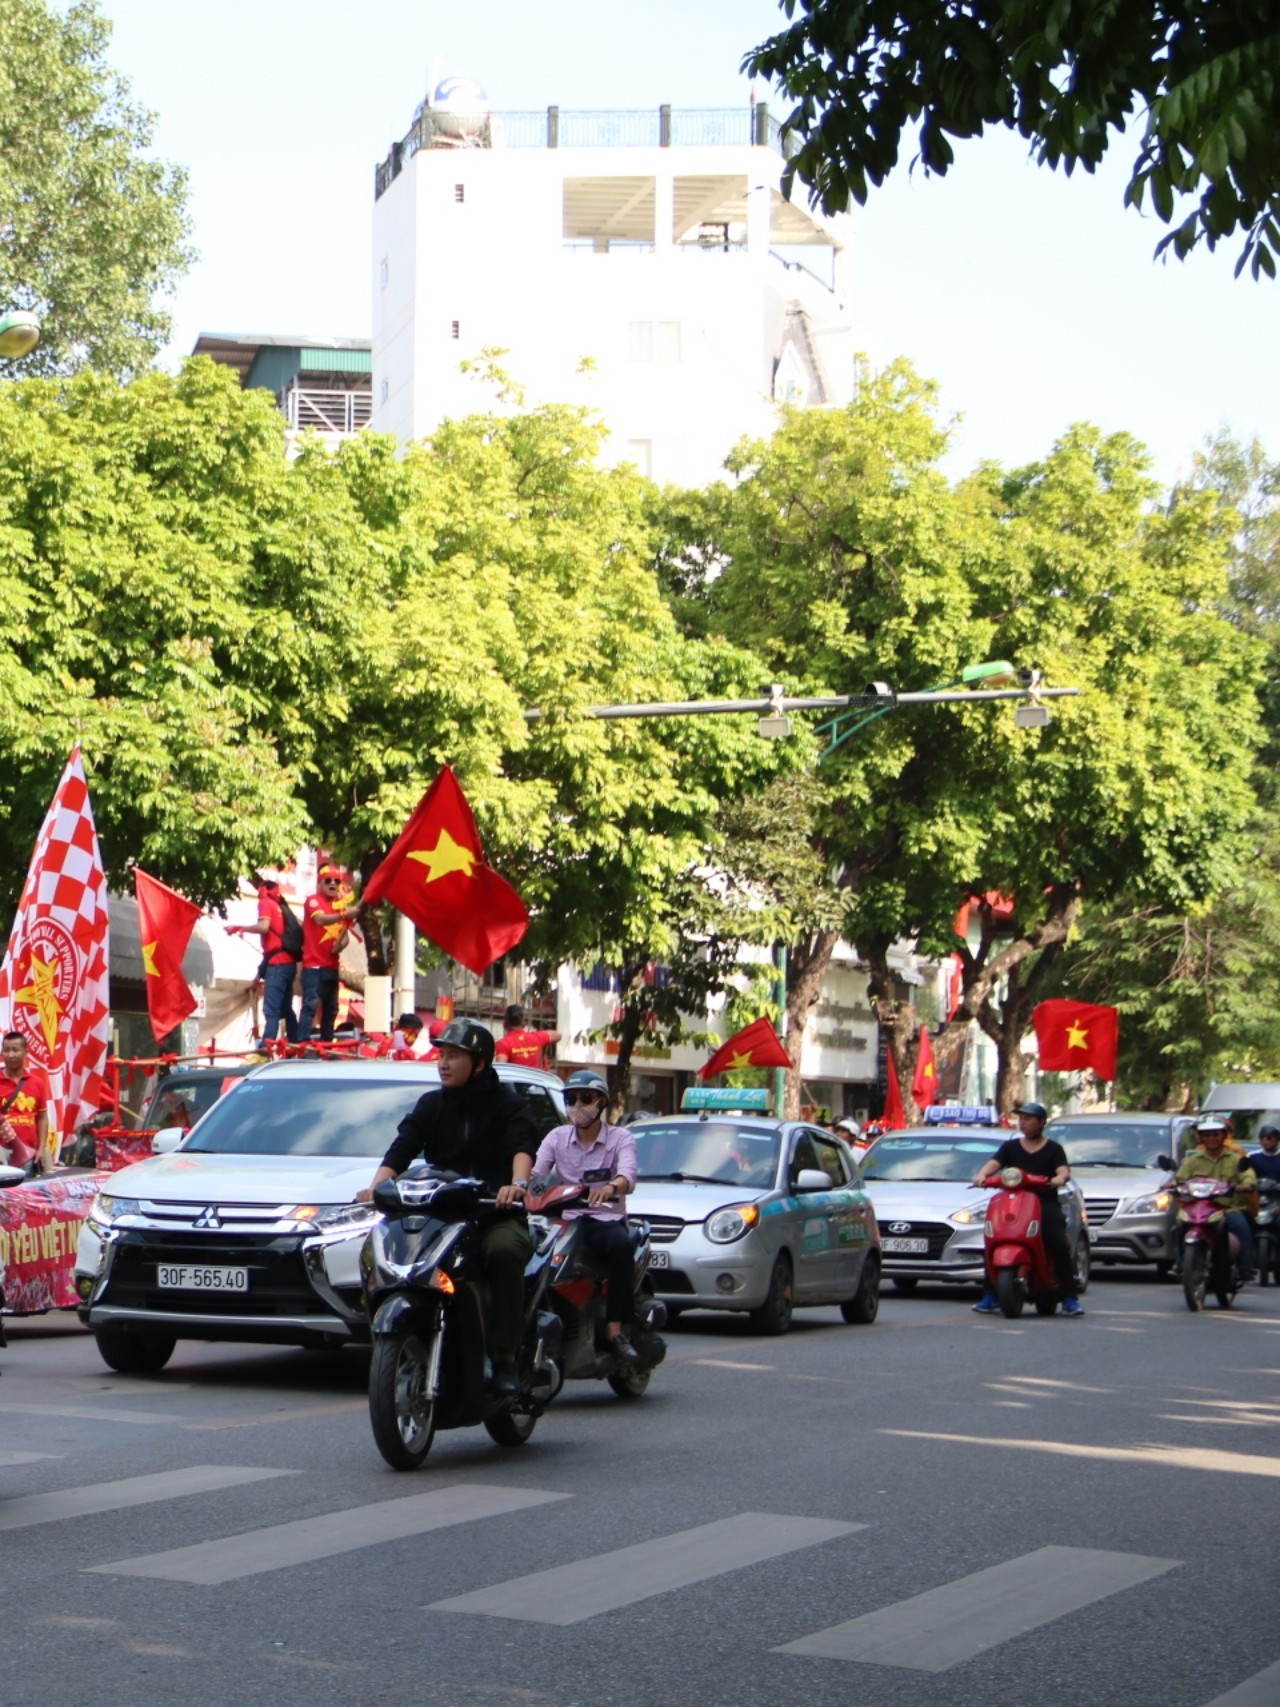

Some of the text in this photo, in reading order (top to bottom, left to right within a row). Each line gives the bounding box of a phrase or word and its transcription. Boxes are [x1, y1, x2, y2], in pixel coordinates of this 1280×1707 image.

[12, 1222, 40, 1265] YÊU
[40, 1216, 66, 1264] VIỆT
[160, 1267, 245, 1288] 30F-565.40
